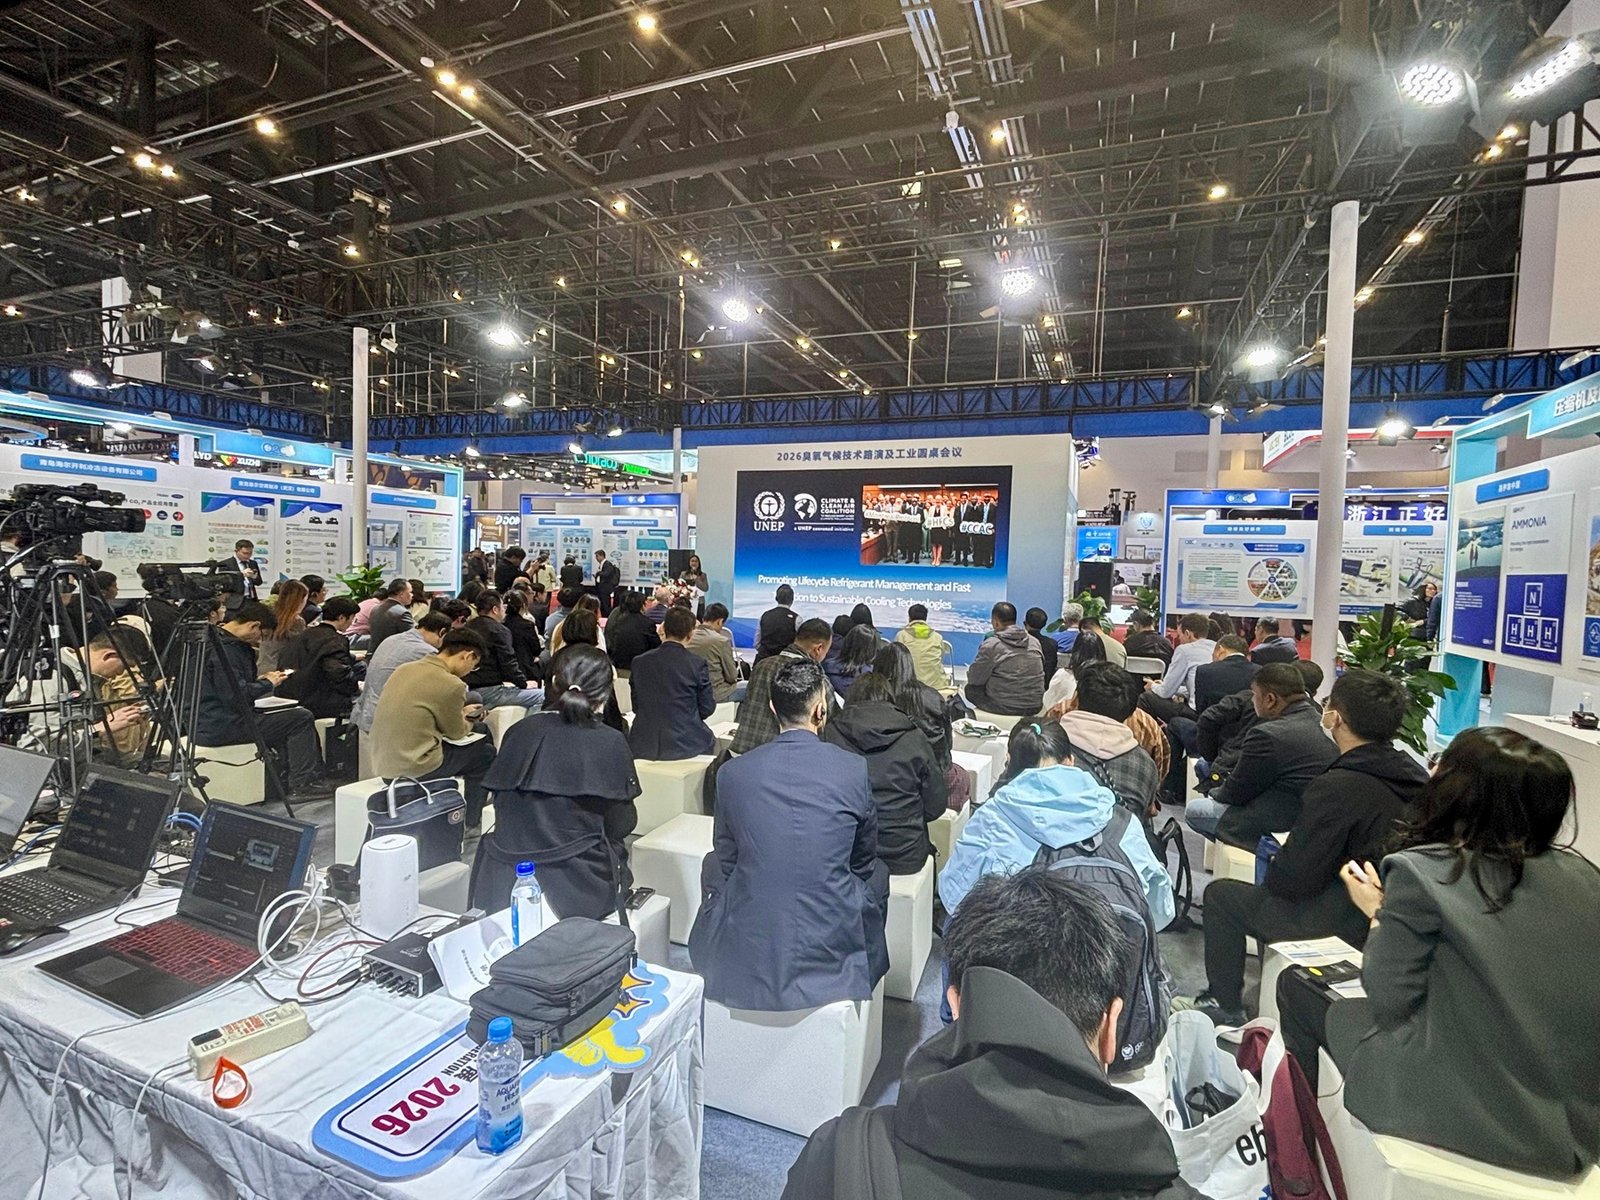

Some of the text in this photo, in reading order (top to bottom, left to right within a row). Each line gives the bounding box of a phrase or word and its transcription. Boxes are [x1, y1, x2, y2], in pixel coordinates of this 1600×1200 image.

[1554, 386, 1600, 417] 压缩机及
[777, 446, 963, 462] 2026臭氧气候技术路演及工业圆桌会议
[1347, 505, 1445, 521] 浙江正好
[753, 521, 785, 531] UNEP
[961, 523, 993, 533] #CCAC
[1511, 516, 1547, 530] AMMONIA
[758, 575, 971, 593] Promoting Lifecycle Refrigerant Management and Fast
[810, 593, 818, 602] to
[818, 593, 863, 605] Sustainable
[864, 595, 896, 608] Cooling
[896, 597, 952, 610] Technologies
[1529, 591, 1537, 604] N
[1511, 623, 1552, 640] H H H
[371, 1076, 461, 1136] 2026
